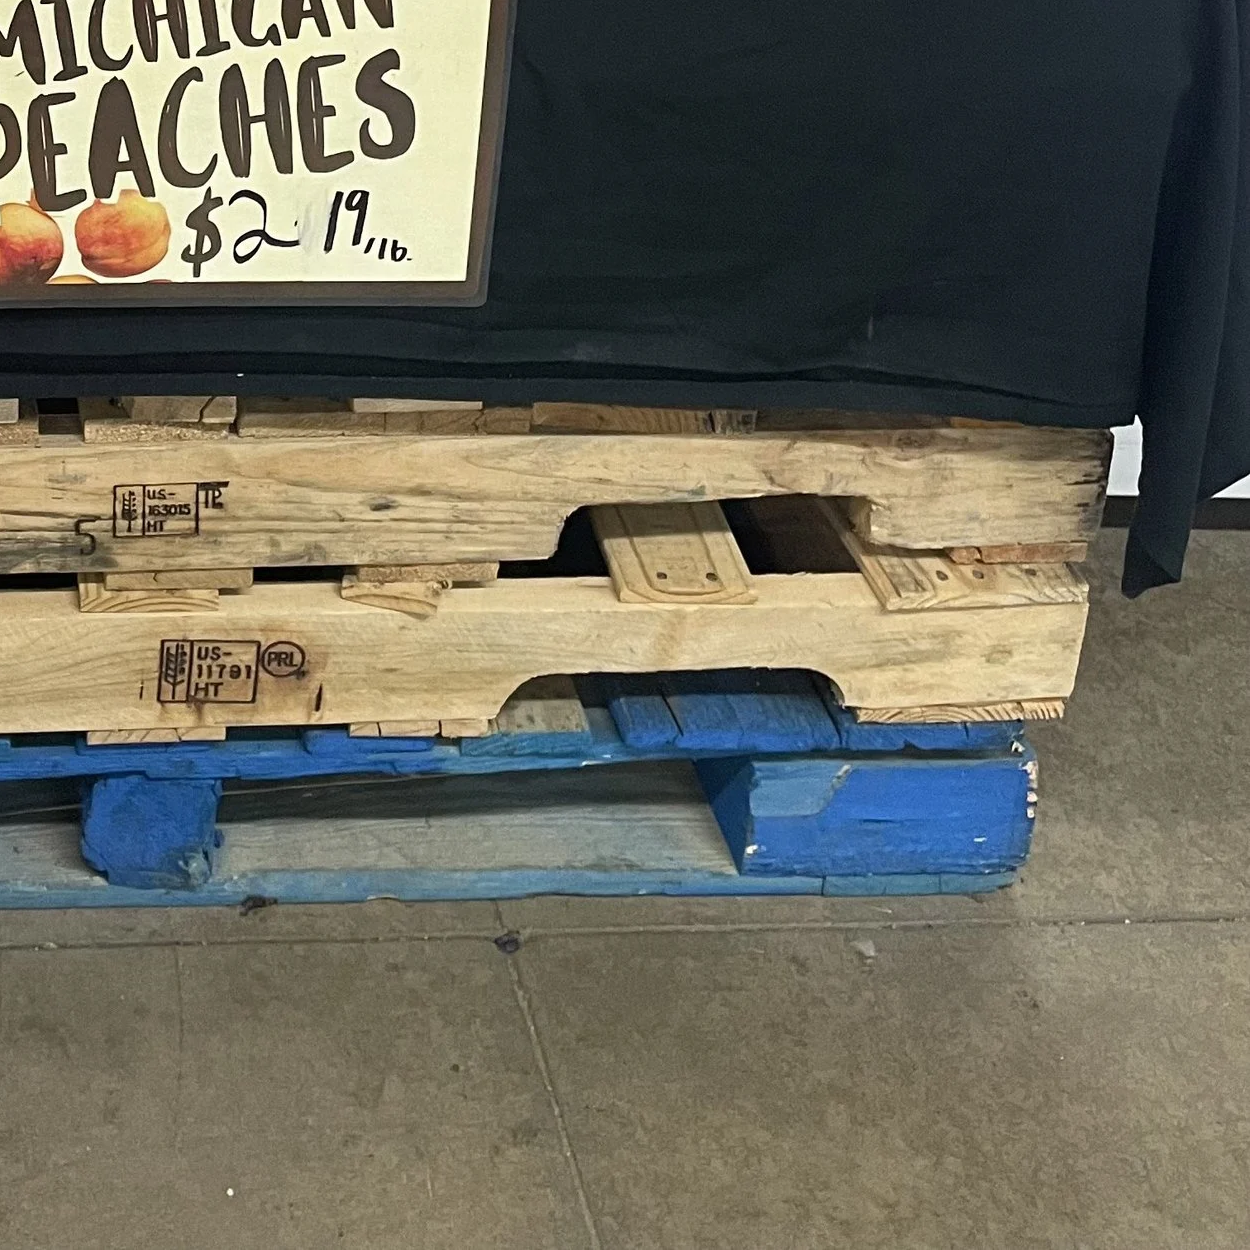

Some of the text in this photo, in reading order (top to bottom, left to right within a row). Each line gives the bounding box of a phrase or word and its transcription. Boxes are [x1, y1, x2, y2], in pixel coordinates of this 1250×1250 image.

[147, 488, 177, 500] US-
[147, 520, 167, 532] HT
[197, 646, 233, 661] US-
[267, 651, 299, 668] PRL
[194, 682, 224, 697] HT
